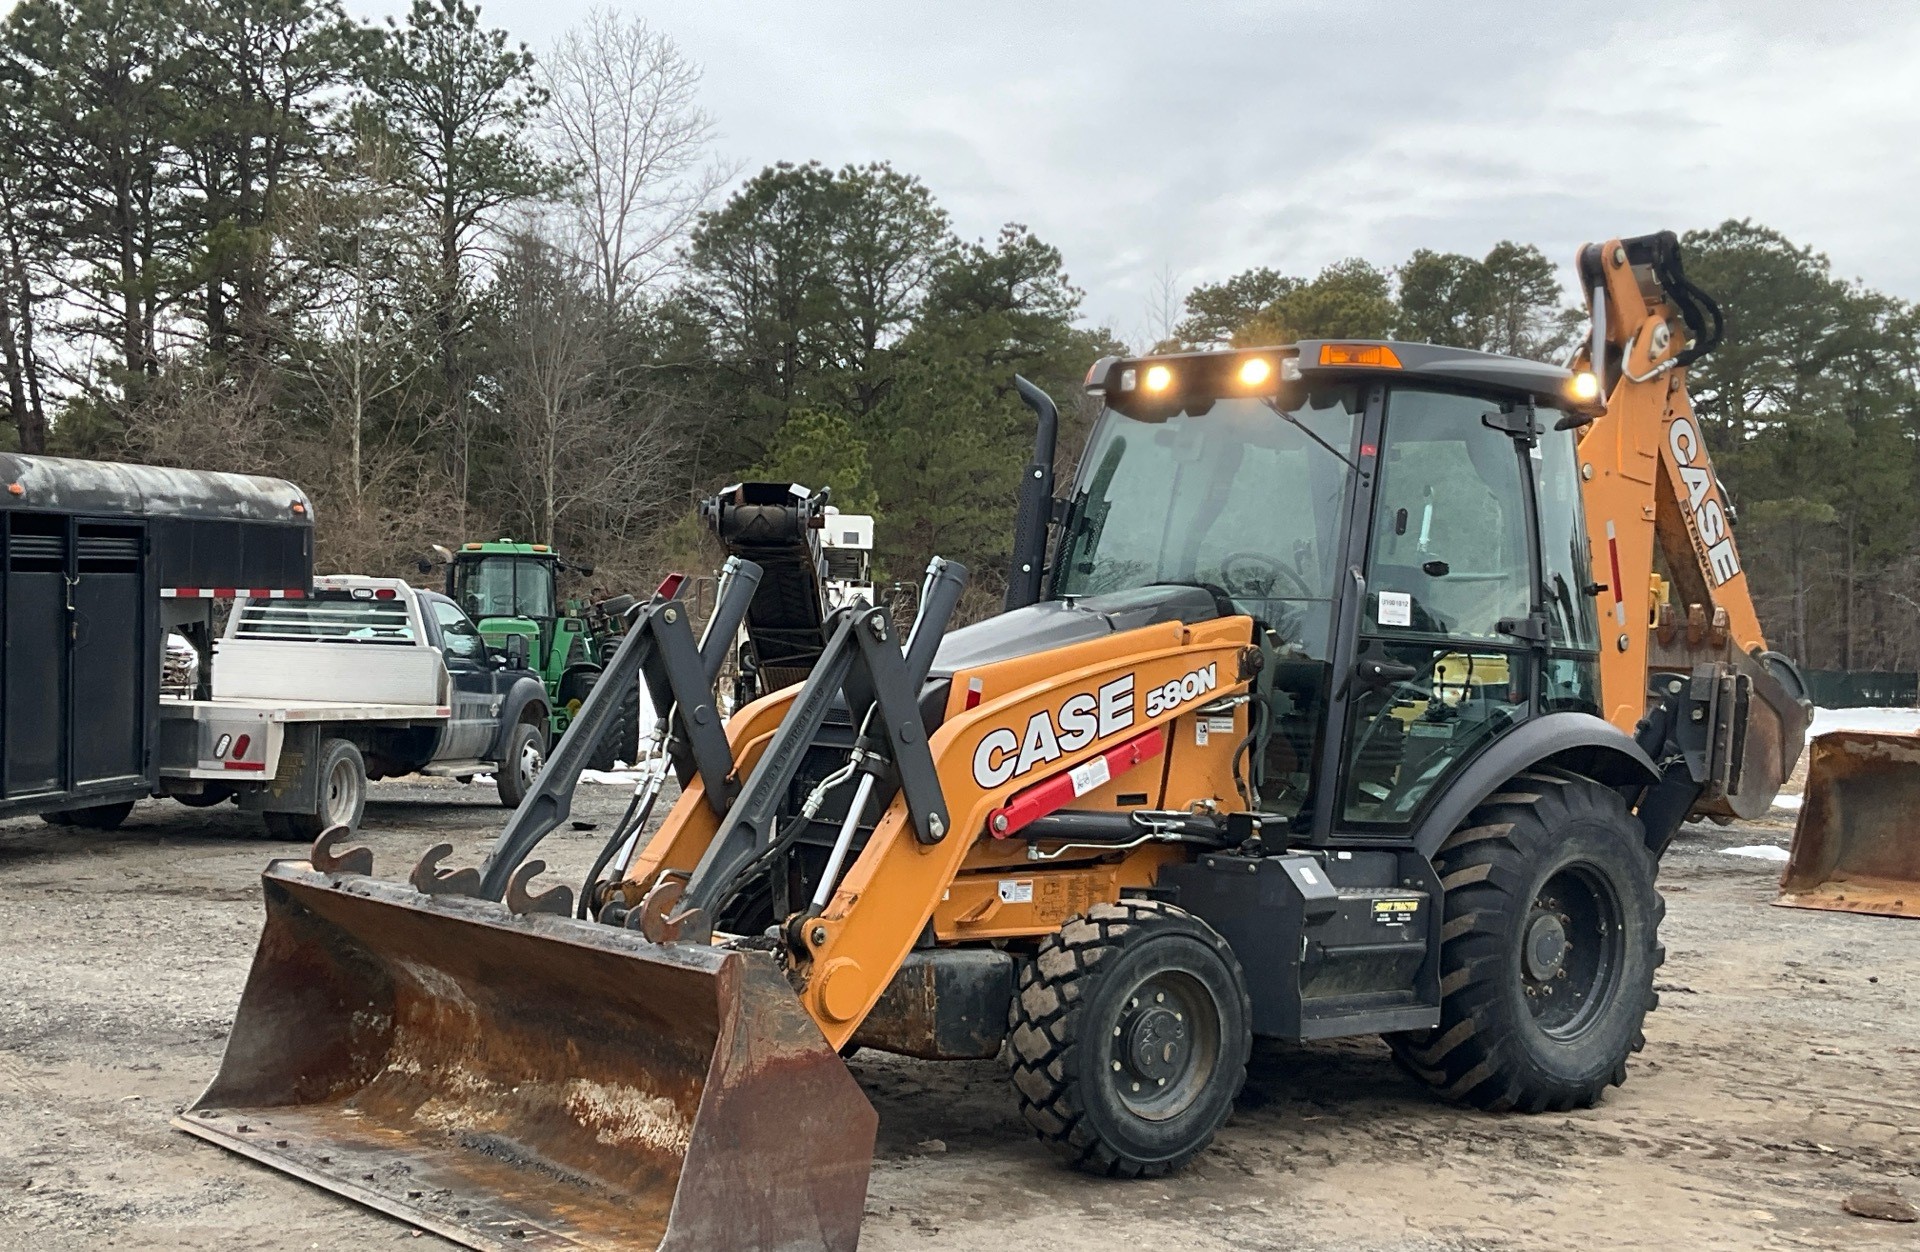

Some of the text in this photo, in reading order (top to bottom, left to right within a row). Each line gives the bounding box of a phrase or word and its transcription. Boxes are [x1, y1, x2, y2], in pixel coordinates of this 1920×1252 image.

[1669, 417, 1740, 588] CASE
[972, 662, 1217, 790] CASE 580N
